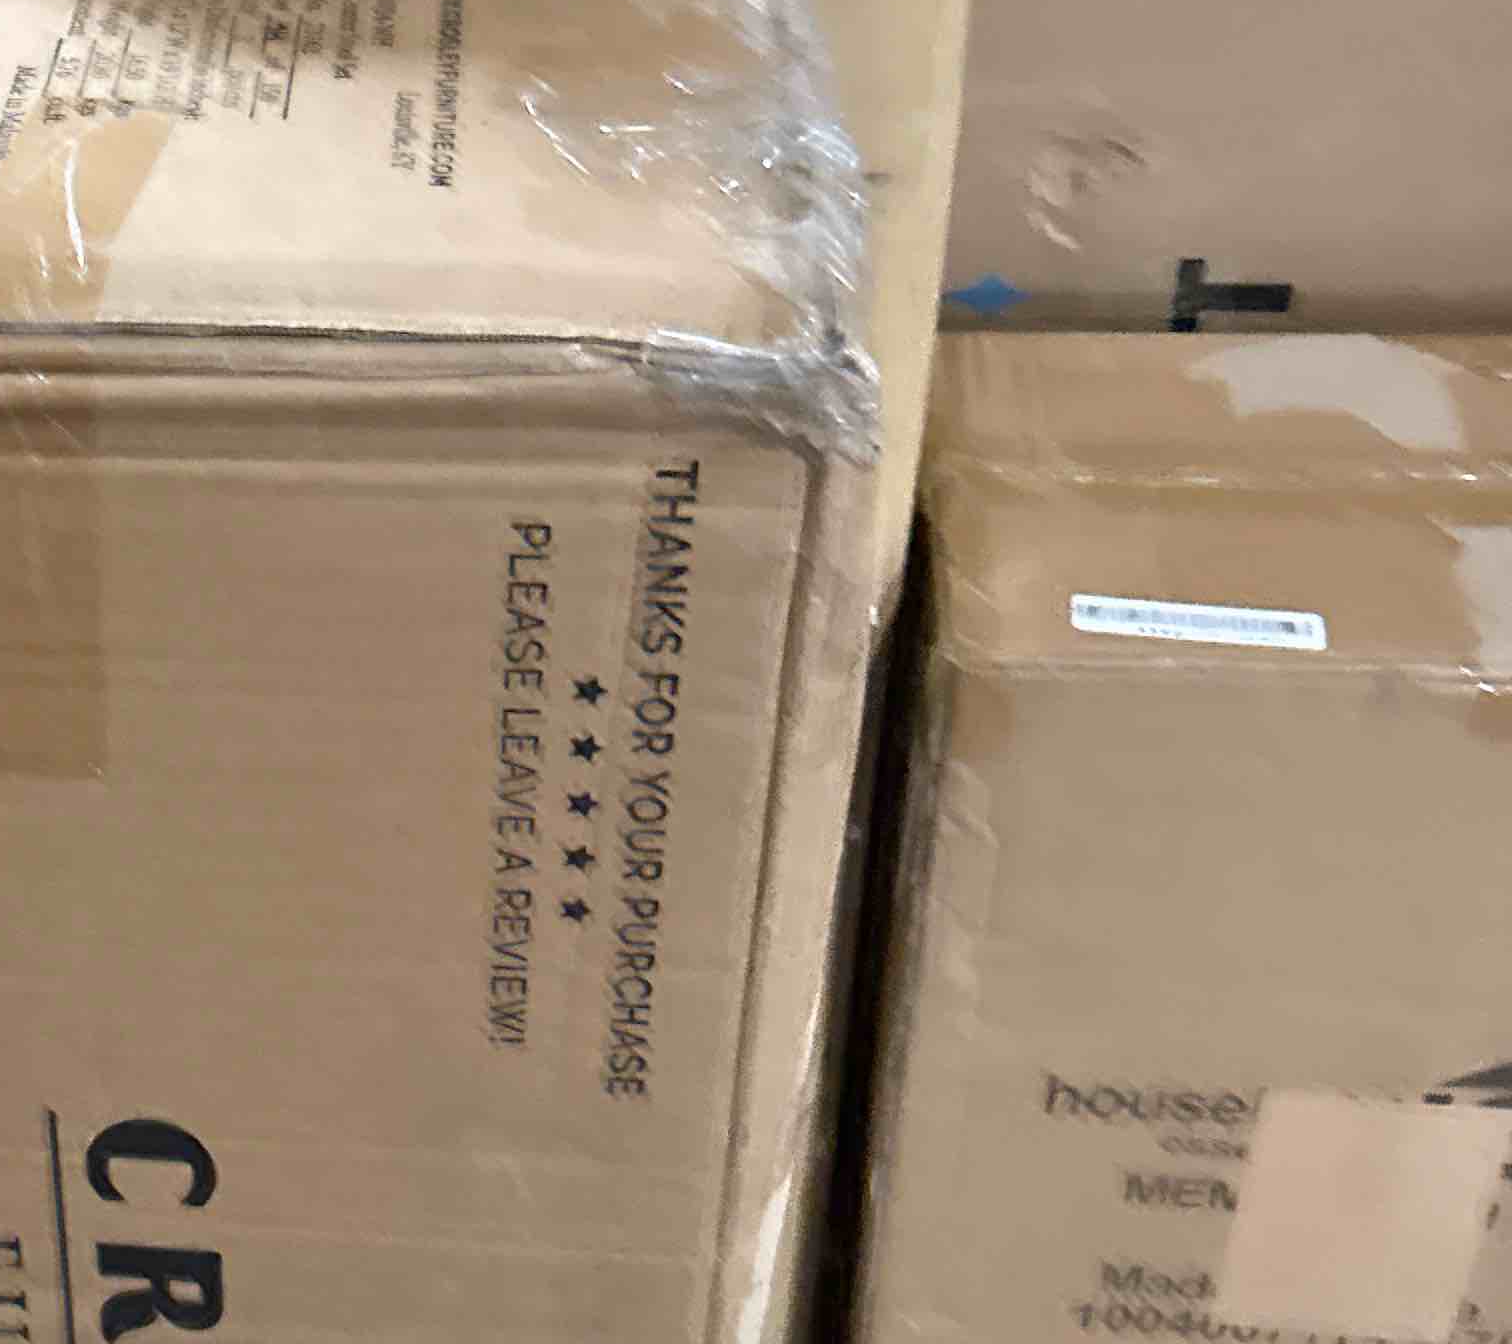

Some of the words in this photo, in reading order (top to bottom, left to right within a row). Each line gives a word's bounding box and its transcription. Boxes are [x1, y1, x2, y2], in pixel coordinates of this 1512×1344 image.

[501, 520, 552, 692] PLEASE
[638, 459, 701, 656] THANKS
[495, 706, 541, 836] LEAVE
[631, 671, 679, 754] FOR
[493, 848, 533, 877] A
[622, 761, 671, 883] YOUR
[488, 886, 532, 1047] REVIEW!
[606, 892, 661, 1099] PURCHASE
[1043, 1072, 1268, 1126] house
[1099, 1260, 1218, 1299] Mad
